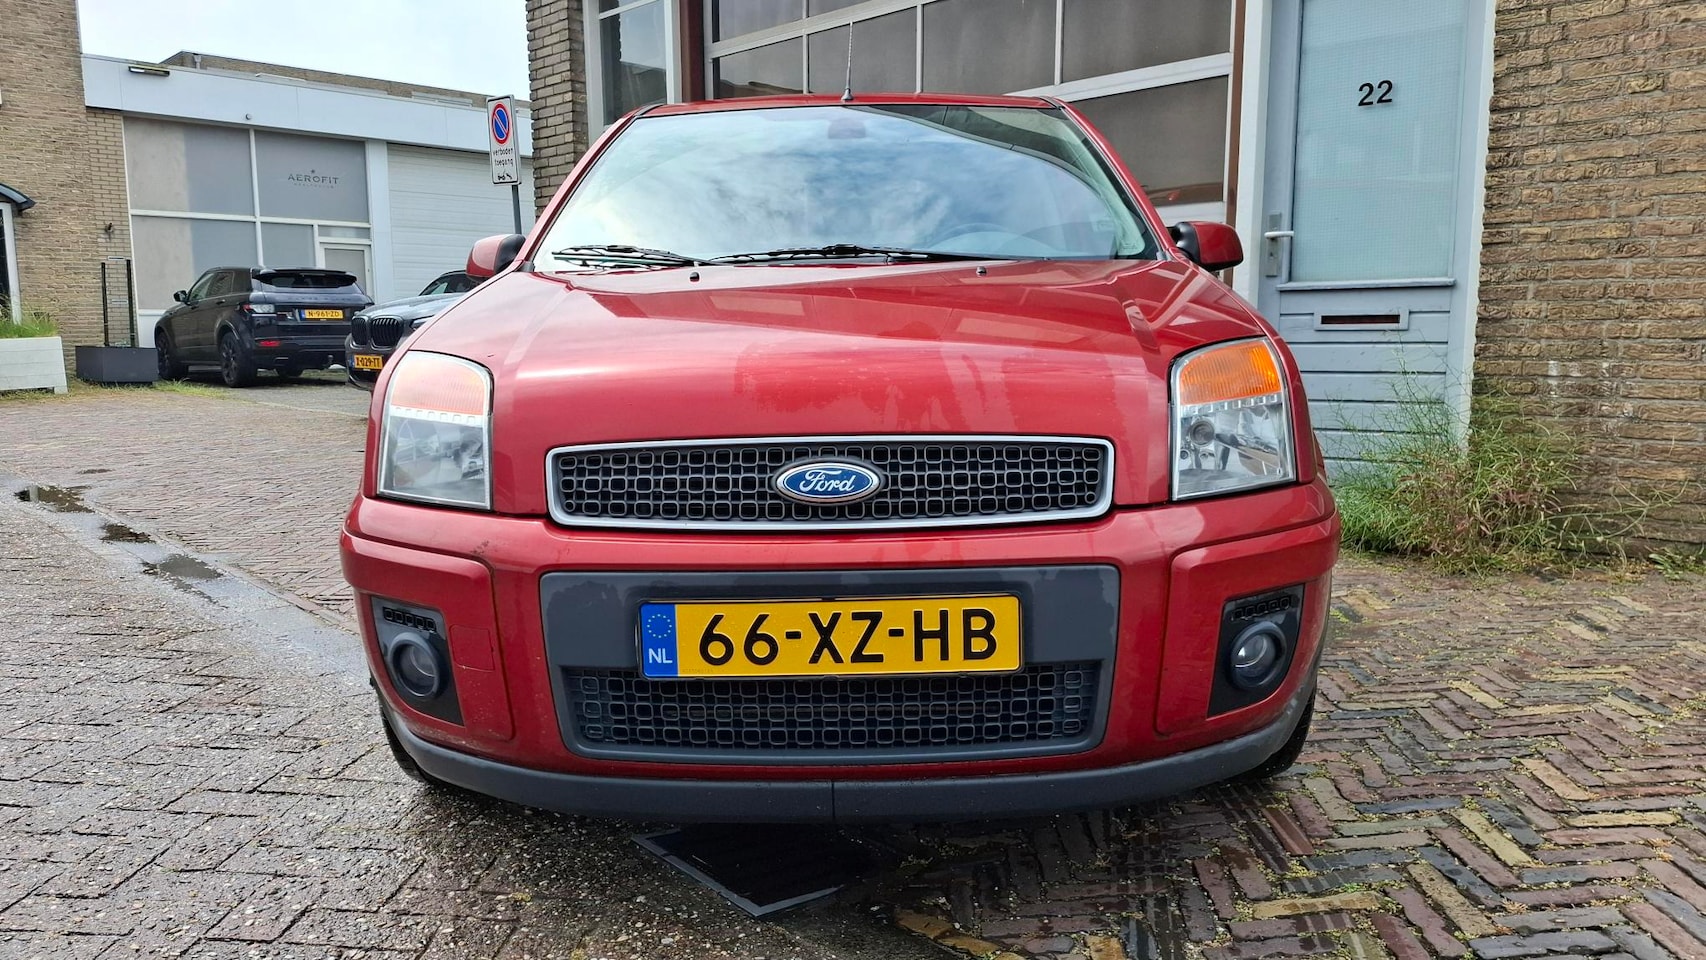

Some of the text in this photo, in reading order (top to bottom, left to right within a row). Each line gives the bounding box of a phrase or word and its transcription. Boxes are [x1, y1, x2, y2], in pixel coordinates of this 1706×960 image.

[1358, 80, 1393, 106] 22
[287, 173, 340, 185] AEROFIT
[799, 469, 856, 492] Ford
[698, 608, 997, 666] 66-XZ-HB
[648, 647, 673, 664] NL
